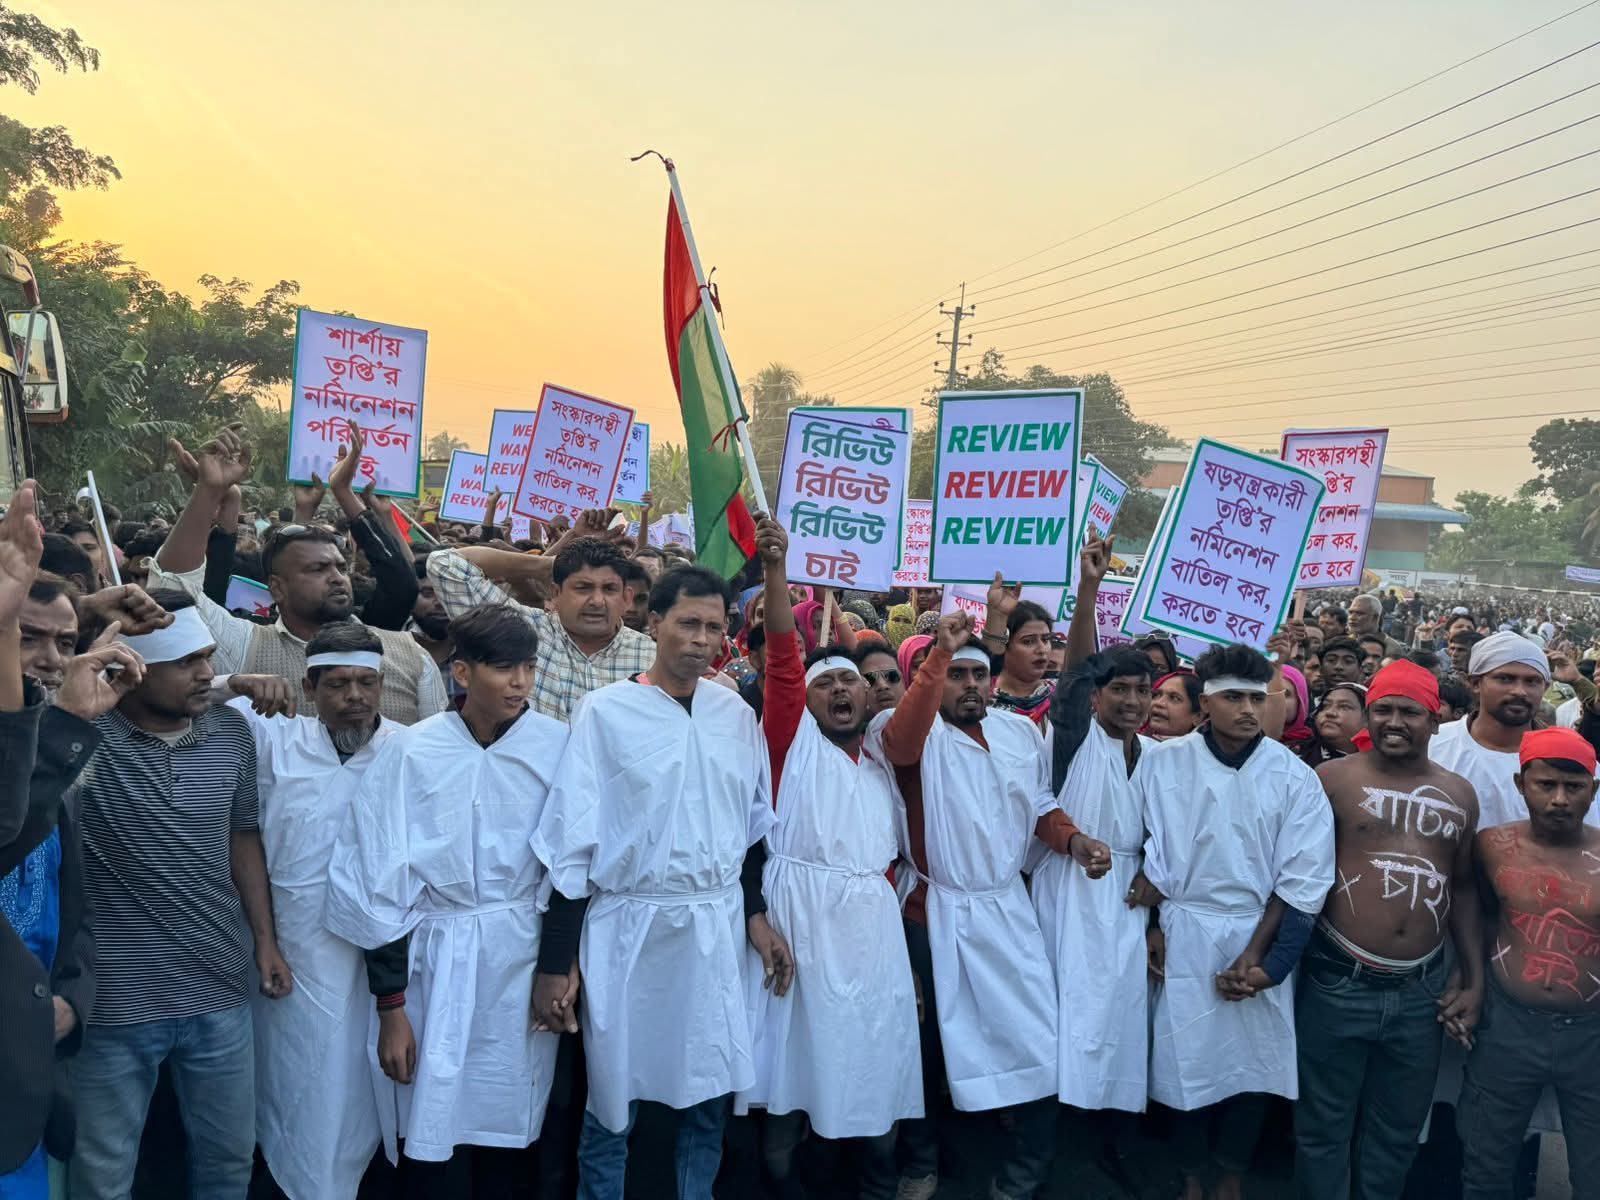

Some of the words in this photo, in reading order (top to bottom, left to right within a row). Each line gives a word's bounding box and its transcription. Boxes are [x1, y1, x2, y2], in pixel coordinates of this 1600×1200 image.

[326, 327, 405, 358] শার্শায়
[303, 382, 417, 422] নমিনেশন
[552, 399, 622, 437] সংস্কারপন্থী
[500, 443, 529, 457] WAN
[801, 422, 896, 466] রিভিউ
[947, 422, 1071, 452] REVIEW
[490, 462, 522, 476] REVI
[544, 445, 604, 480] নমিনেশন
[1295, 439, 1379, 469] সংস্কারপন্থী
[460, 478, 482, 492] WA
[473, 464, 486, 476] W
[795, 461, 891, 505] রিভিউ
[944, 470, 1069, 499] REVIEW
[534, 469, 573, 496] বাতিল
[576, 482, 599, 507] কর,
[1096, 480, 1120, 506] VIEW
[528, 491, 568, 517] করতে
[1090, 501, 1112, 525] VIEW
[790, 501, 887, 545] রিভিউ
[942, 517, 1066, 545] REVIEW
[1190, 525, 1280, 574] নমিনেশন
[1331, 532, 1359, 553] কর,
[805, 550, 861, 586] চাই
[1325, 560, 1356, 581] হবে
[1170, 556, 1233, 596] বাতিল
[1236, 576, 1272, 614] কর,
[1161, 590, 1222, 626] করতে
[1224, 610, 1266, 642] হবে
